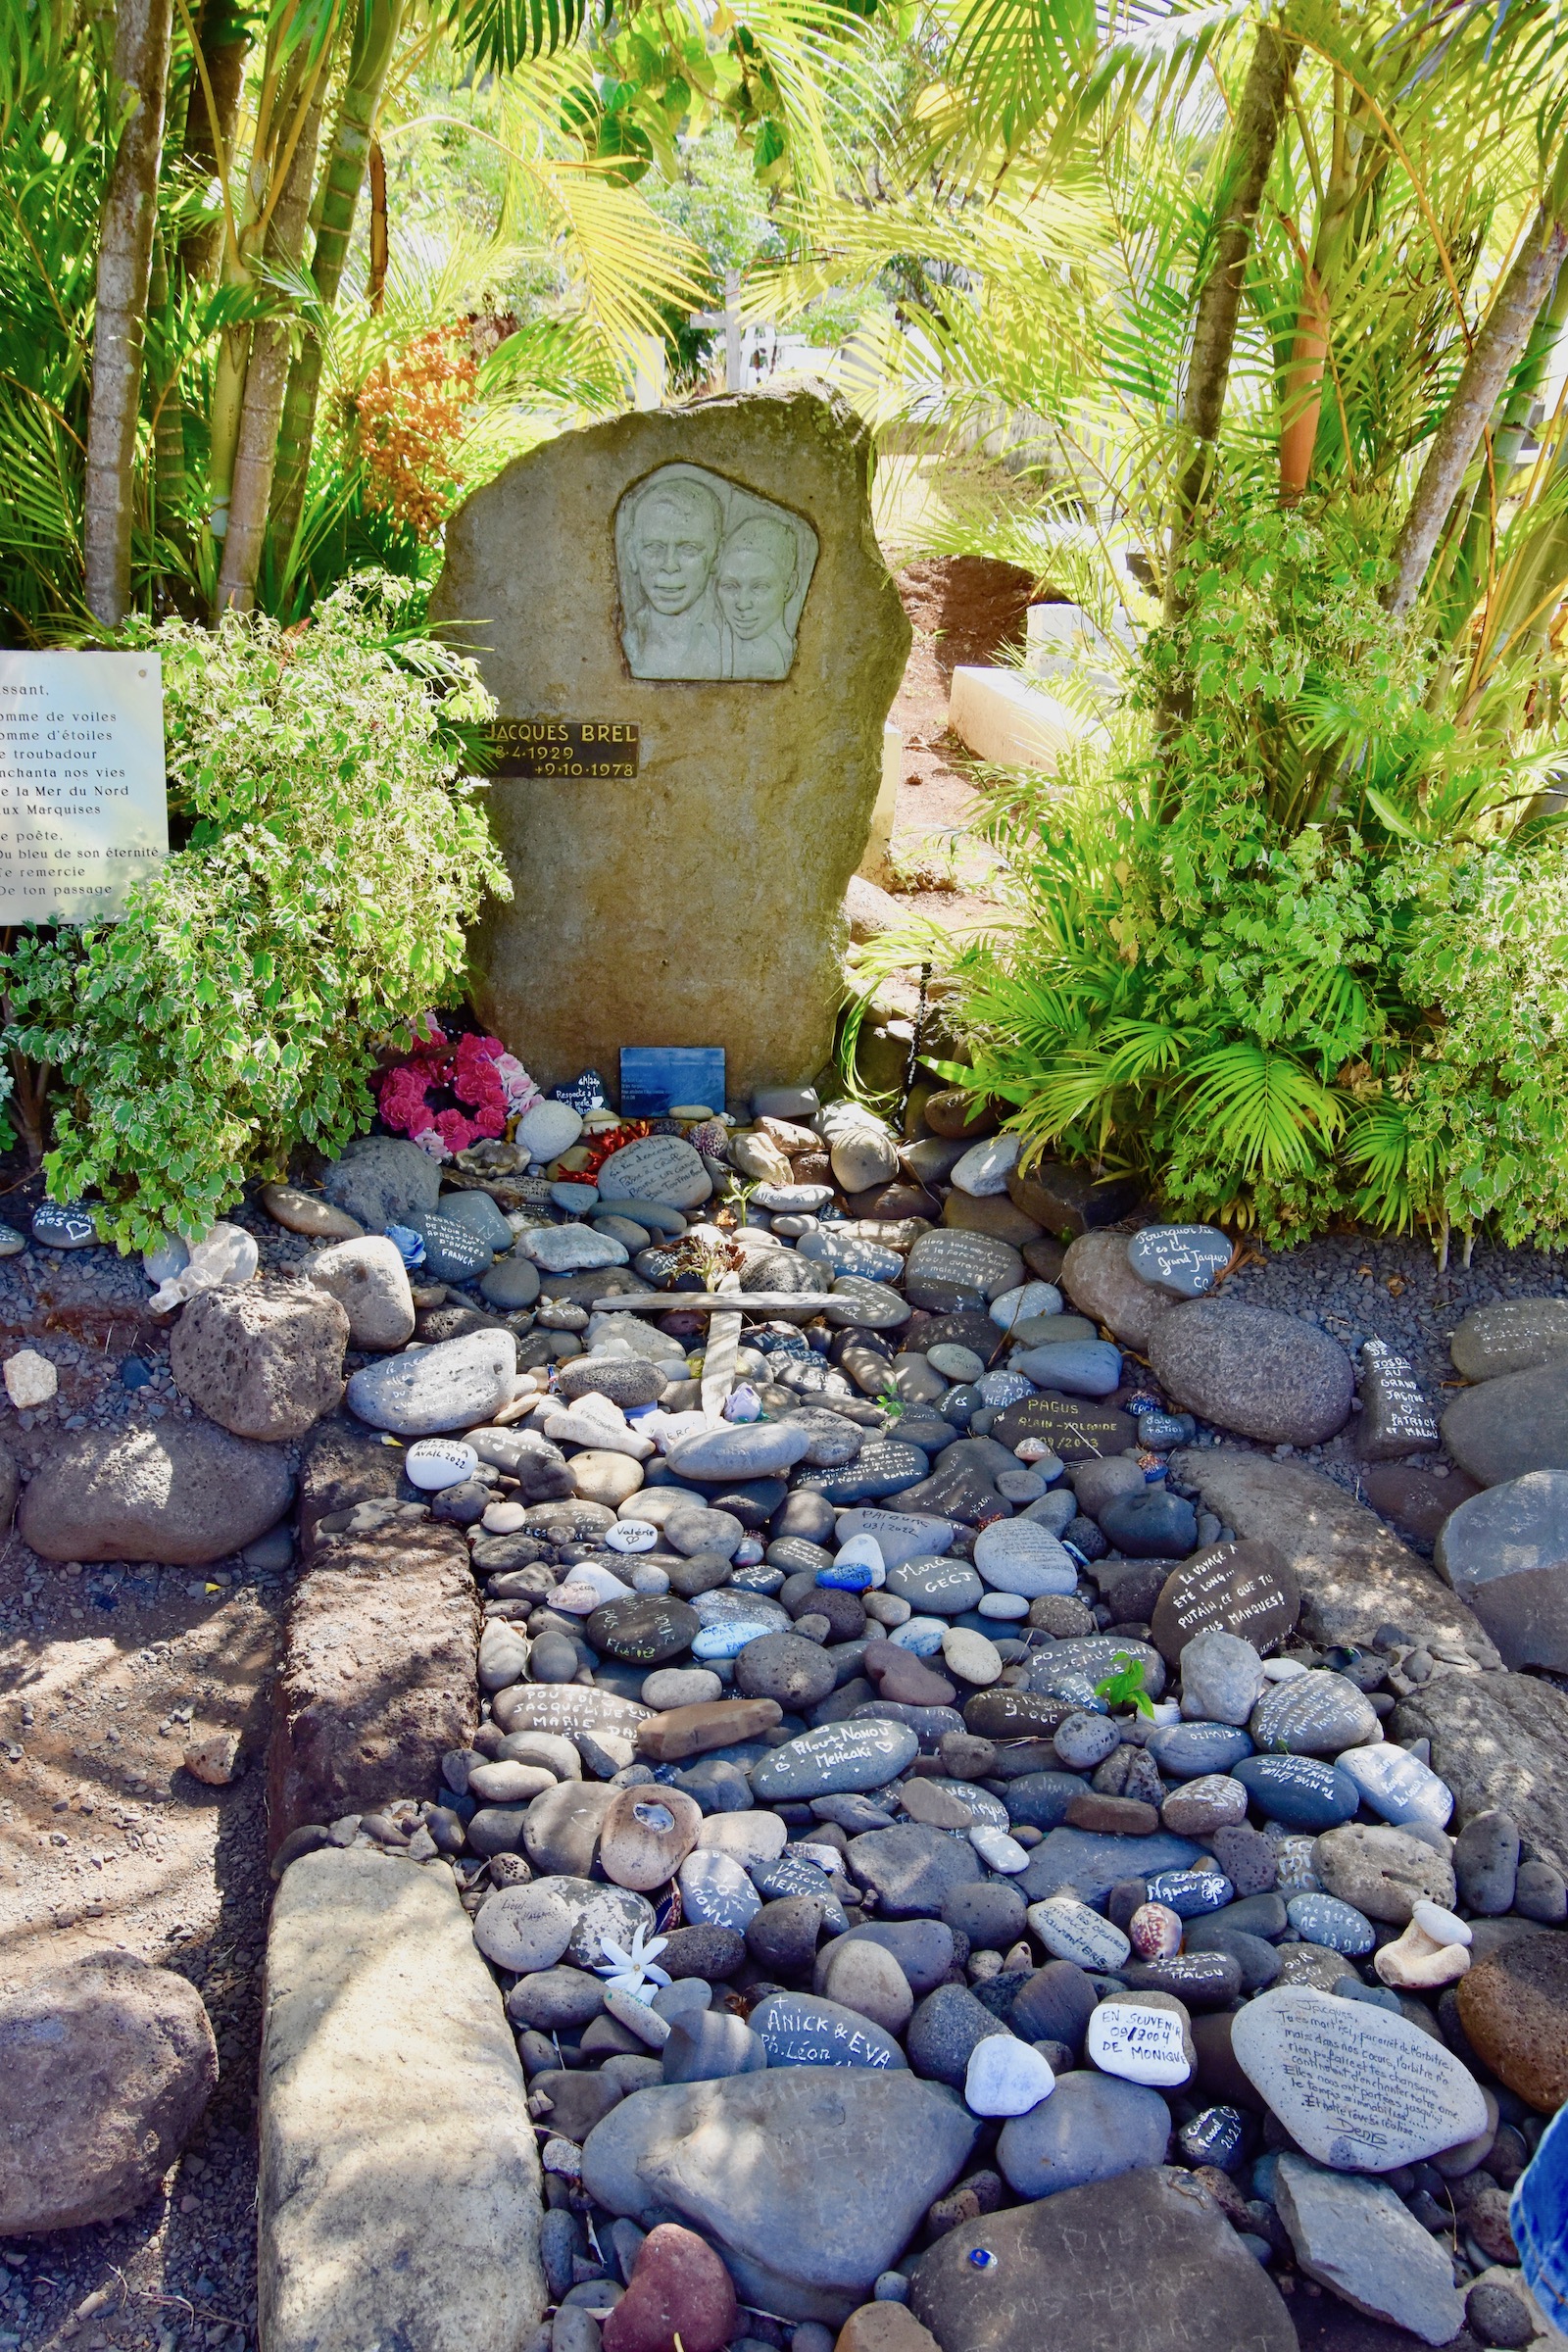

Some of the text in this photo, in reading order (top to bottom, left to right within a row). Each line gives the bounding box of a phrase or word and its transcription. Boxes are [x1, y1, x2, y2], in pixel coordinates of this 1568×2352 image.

[47, 711, 65, 722] de
[74, 711, 117, 722] voiles
[47, 728, 113, 741] d'étoiles
[485, 724, 637, 743] JACQUES BREL
[14, 749, 97, 760] troubadour
[65, 769, 88, 778] nos
[97, 767, 125, 778] vies
[17, 785, 29, 797] la
[36, 785, 61, 797] Mer
[70, 786, 86, 797] du
[94, 785, 129, 797] Nord
[26, 804, 101, 817] Marquises
[17, 830, 63, 843] poète,
[19, 847, 160, 859] bleu de son éternité
[20, 866, 85, 878] remercie
[24, 884, 113, 899] ton passage
[1136, 1225, 1214, 1246] Pourquoi tu
[1139, 1239, 1190, 1256] t'es tu
[441, 1248, 475, 1266] FRANCK
[1190, 1250, 1229, 1274] Jacques
[1385, 1368, 1401, 1377] AU
[1380, 1379, 1417, 1391] GRAND
[1028, 1399, 1079, 1414] PAGUS
[445, 1452, 466, 1470] 2022
[616, 1526, 656, 1537] Valérie
[1193, 1550, 1227, 1576] VOYAGE
[1237, 1581, 1257, 1597] QUE
[1258, 1574, 1274, 1588] TU
[1173, 1588, 1197, 1609] ÉTÉ
[1102, 2009, 1120, 2024] EN
[1110, 2027, 1170, 2045] 09/2004
[848, 2031, 891, 2070] EVA
[1102, 2041, 1188, 2065] DE MONIQUE
[1341, 2043, 1359, 2056] nos
